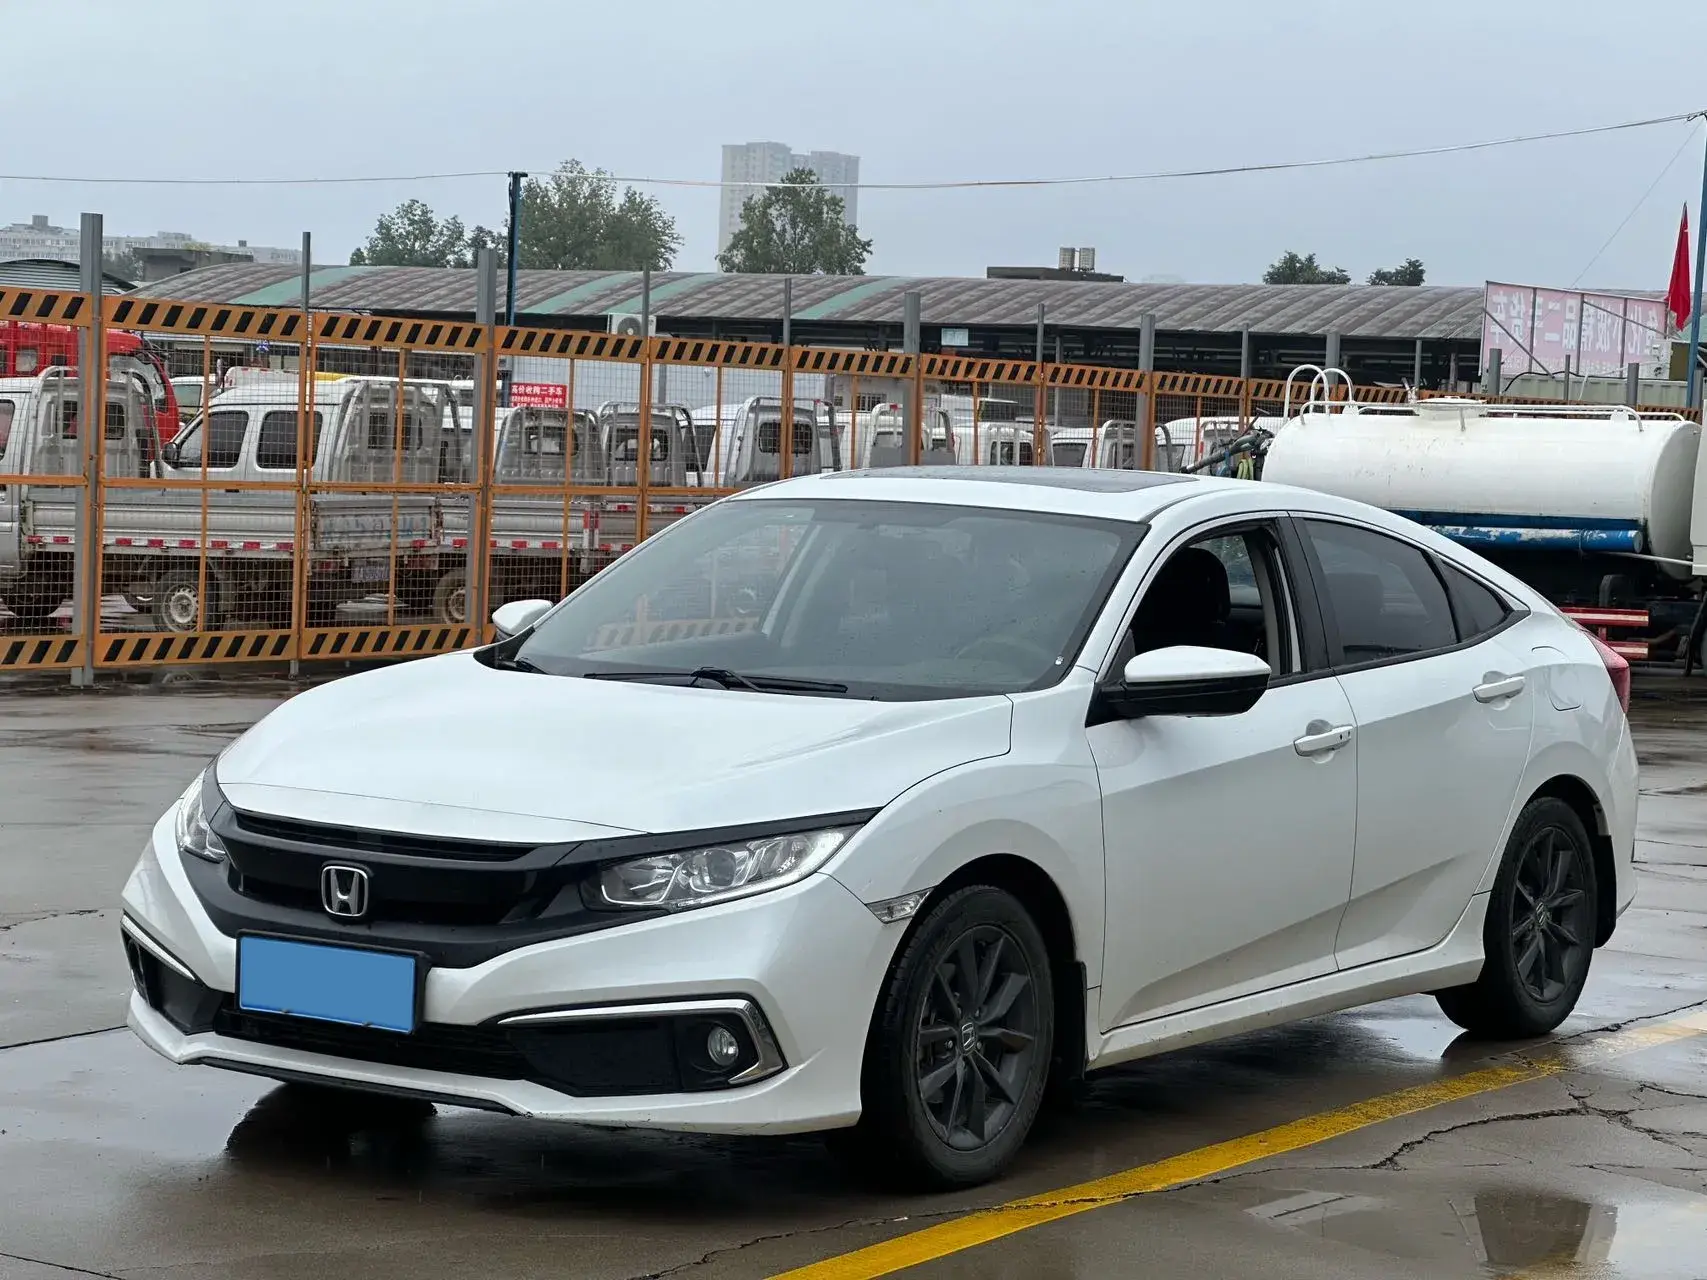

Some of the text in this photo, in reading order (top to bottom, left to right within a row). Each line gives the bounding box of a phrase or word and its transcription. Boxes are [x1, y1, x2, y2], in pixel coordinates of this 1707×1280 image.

[511, 384, 563, 396] 高价收购二手车
